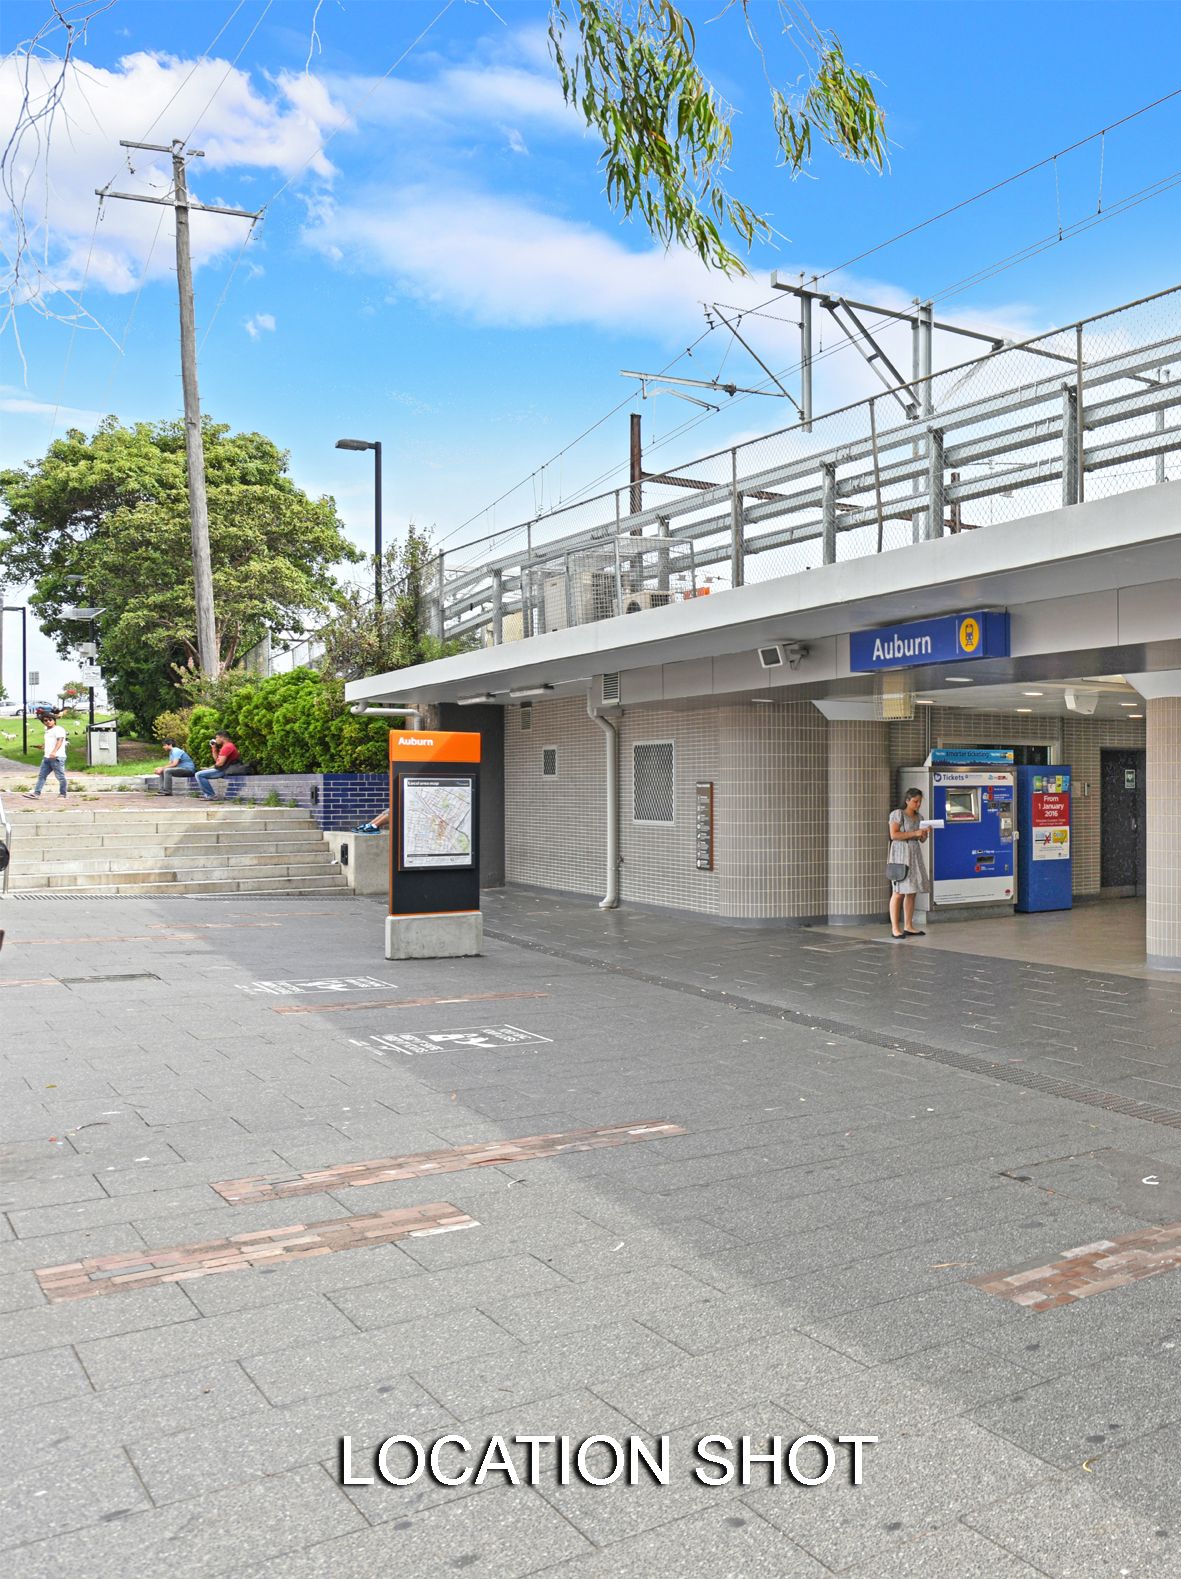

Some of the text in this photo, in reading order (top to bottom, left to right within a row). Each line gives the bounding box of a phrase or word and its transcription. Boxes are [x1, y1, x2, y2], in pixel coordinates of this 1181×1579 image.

[872, 634, 932, 661] Auburn
[398, 736, 434, 746] Auburn
[1042, 803, 1065, 811] January
